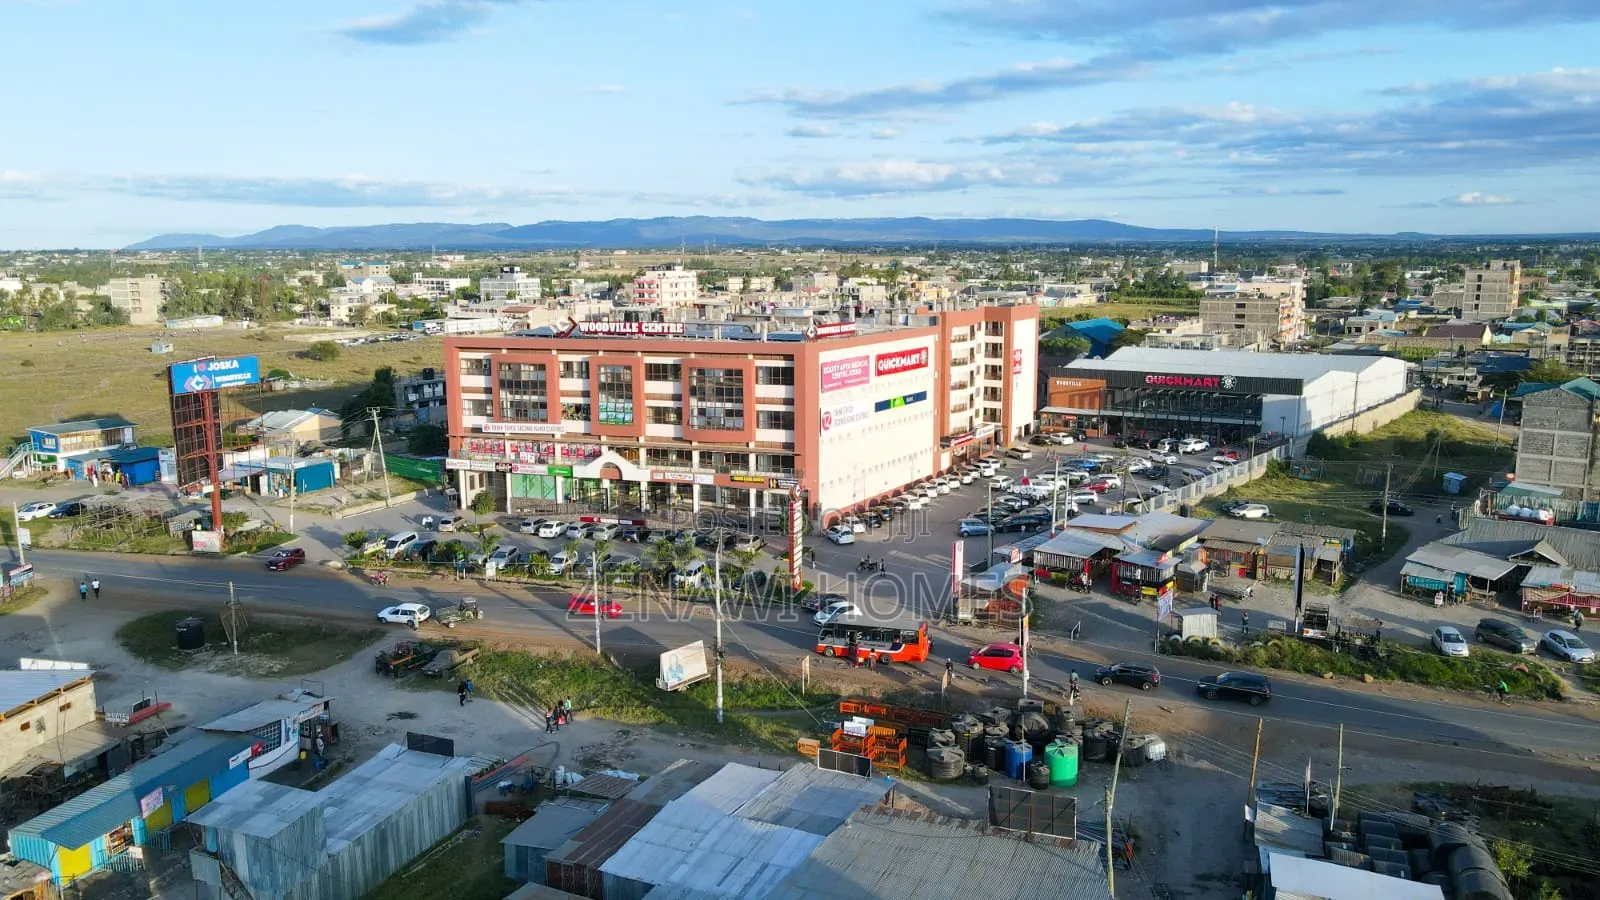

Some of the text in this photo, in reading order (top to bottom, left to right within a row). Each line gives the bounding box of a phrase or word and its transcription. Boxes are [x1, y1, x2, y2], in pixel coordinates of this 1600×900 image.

[580, 322, 683, 333] WOODVILLE CENTRE
[207, 360, 239, 371] JOSKA
[878, 353, 921, 371] QUICKMART
[1145, 375, 1220, 387] QUICKMART
